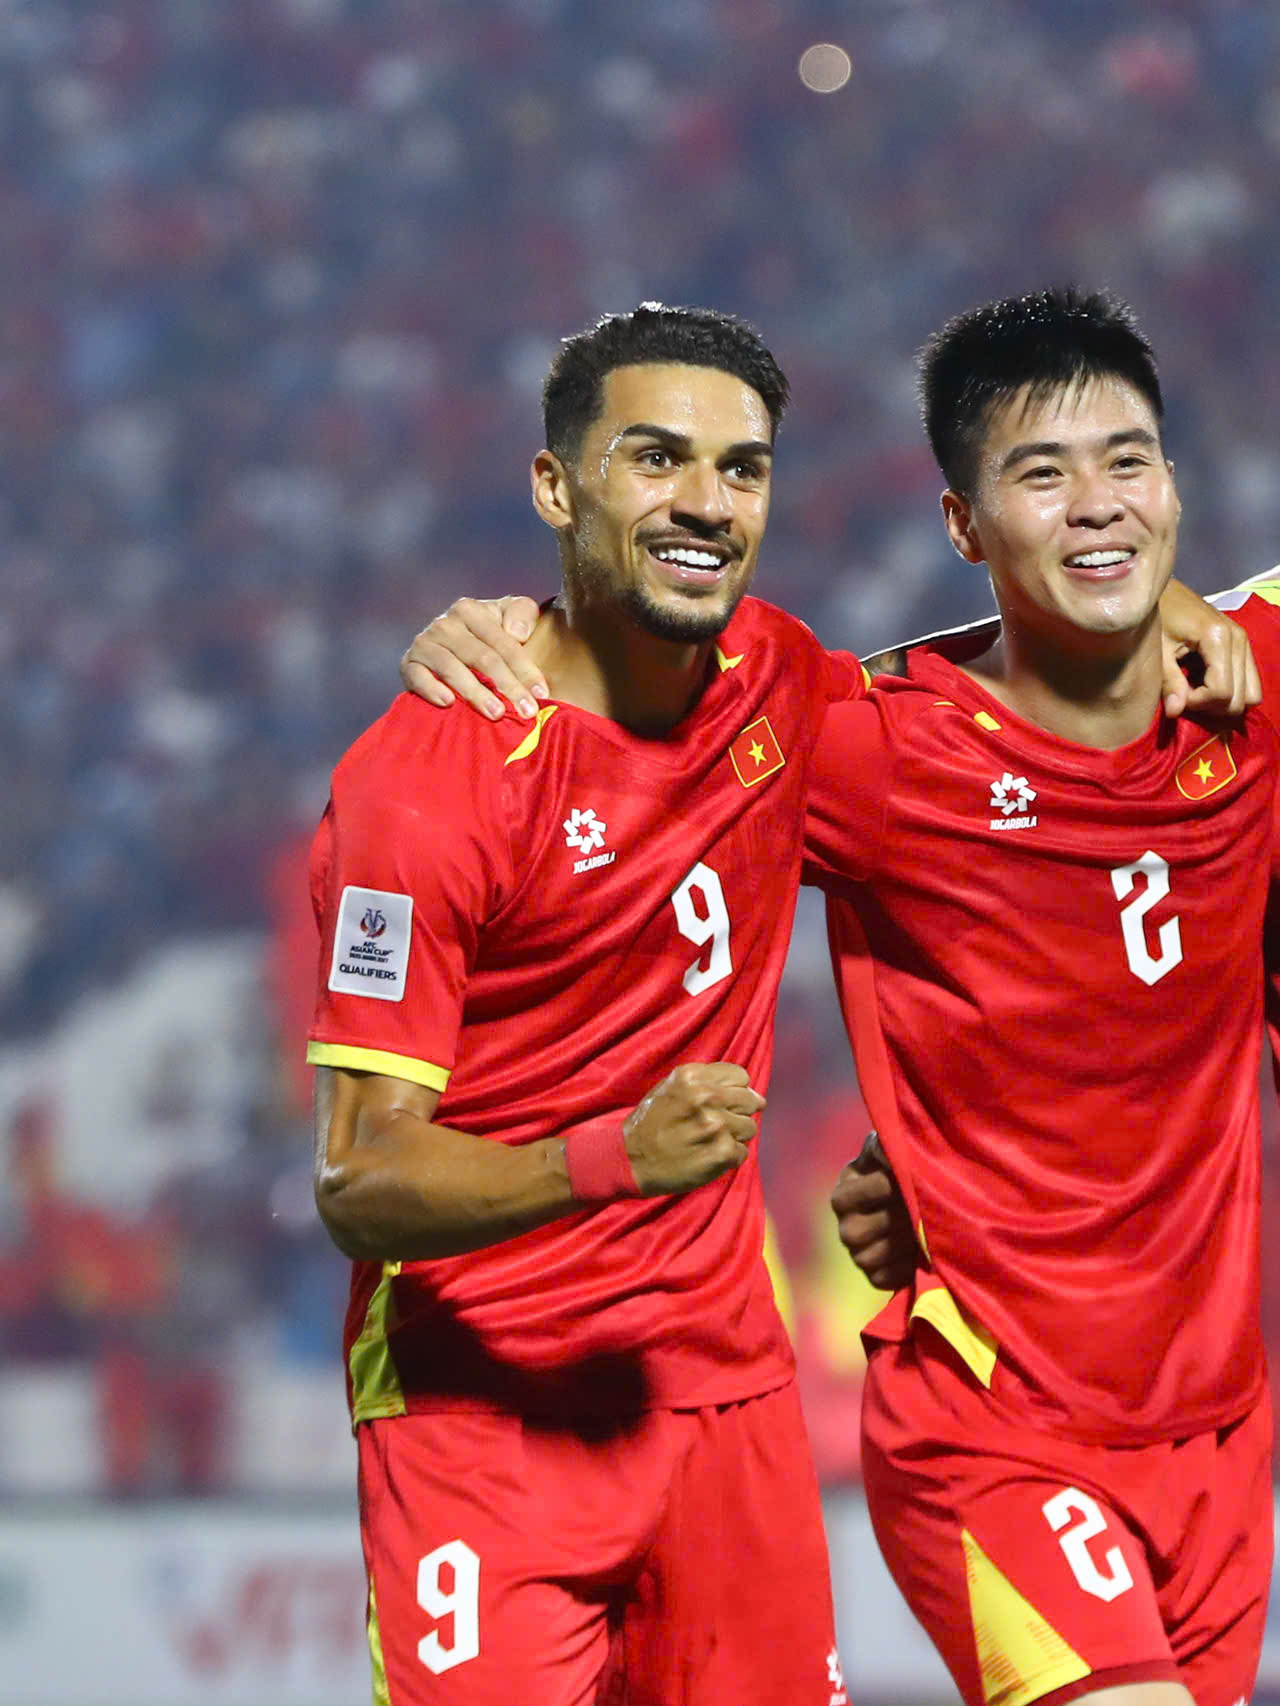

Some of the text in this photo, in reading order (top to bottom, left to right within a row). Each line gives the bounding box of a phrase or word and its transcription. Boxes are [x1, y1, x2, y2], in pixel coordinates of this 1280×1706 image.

[339, 963, 396, 980] QUALIFIERS
[350, 945, 373, 954] ASIAN
[363, 941, 377, 949] AFC
[671, 861, 733, 997] 9
[1110, 850, 1183, 986] 2
[1042, 1487, 1133, 1602] 2
[417, 1539, 480, 1675] 9
